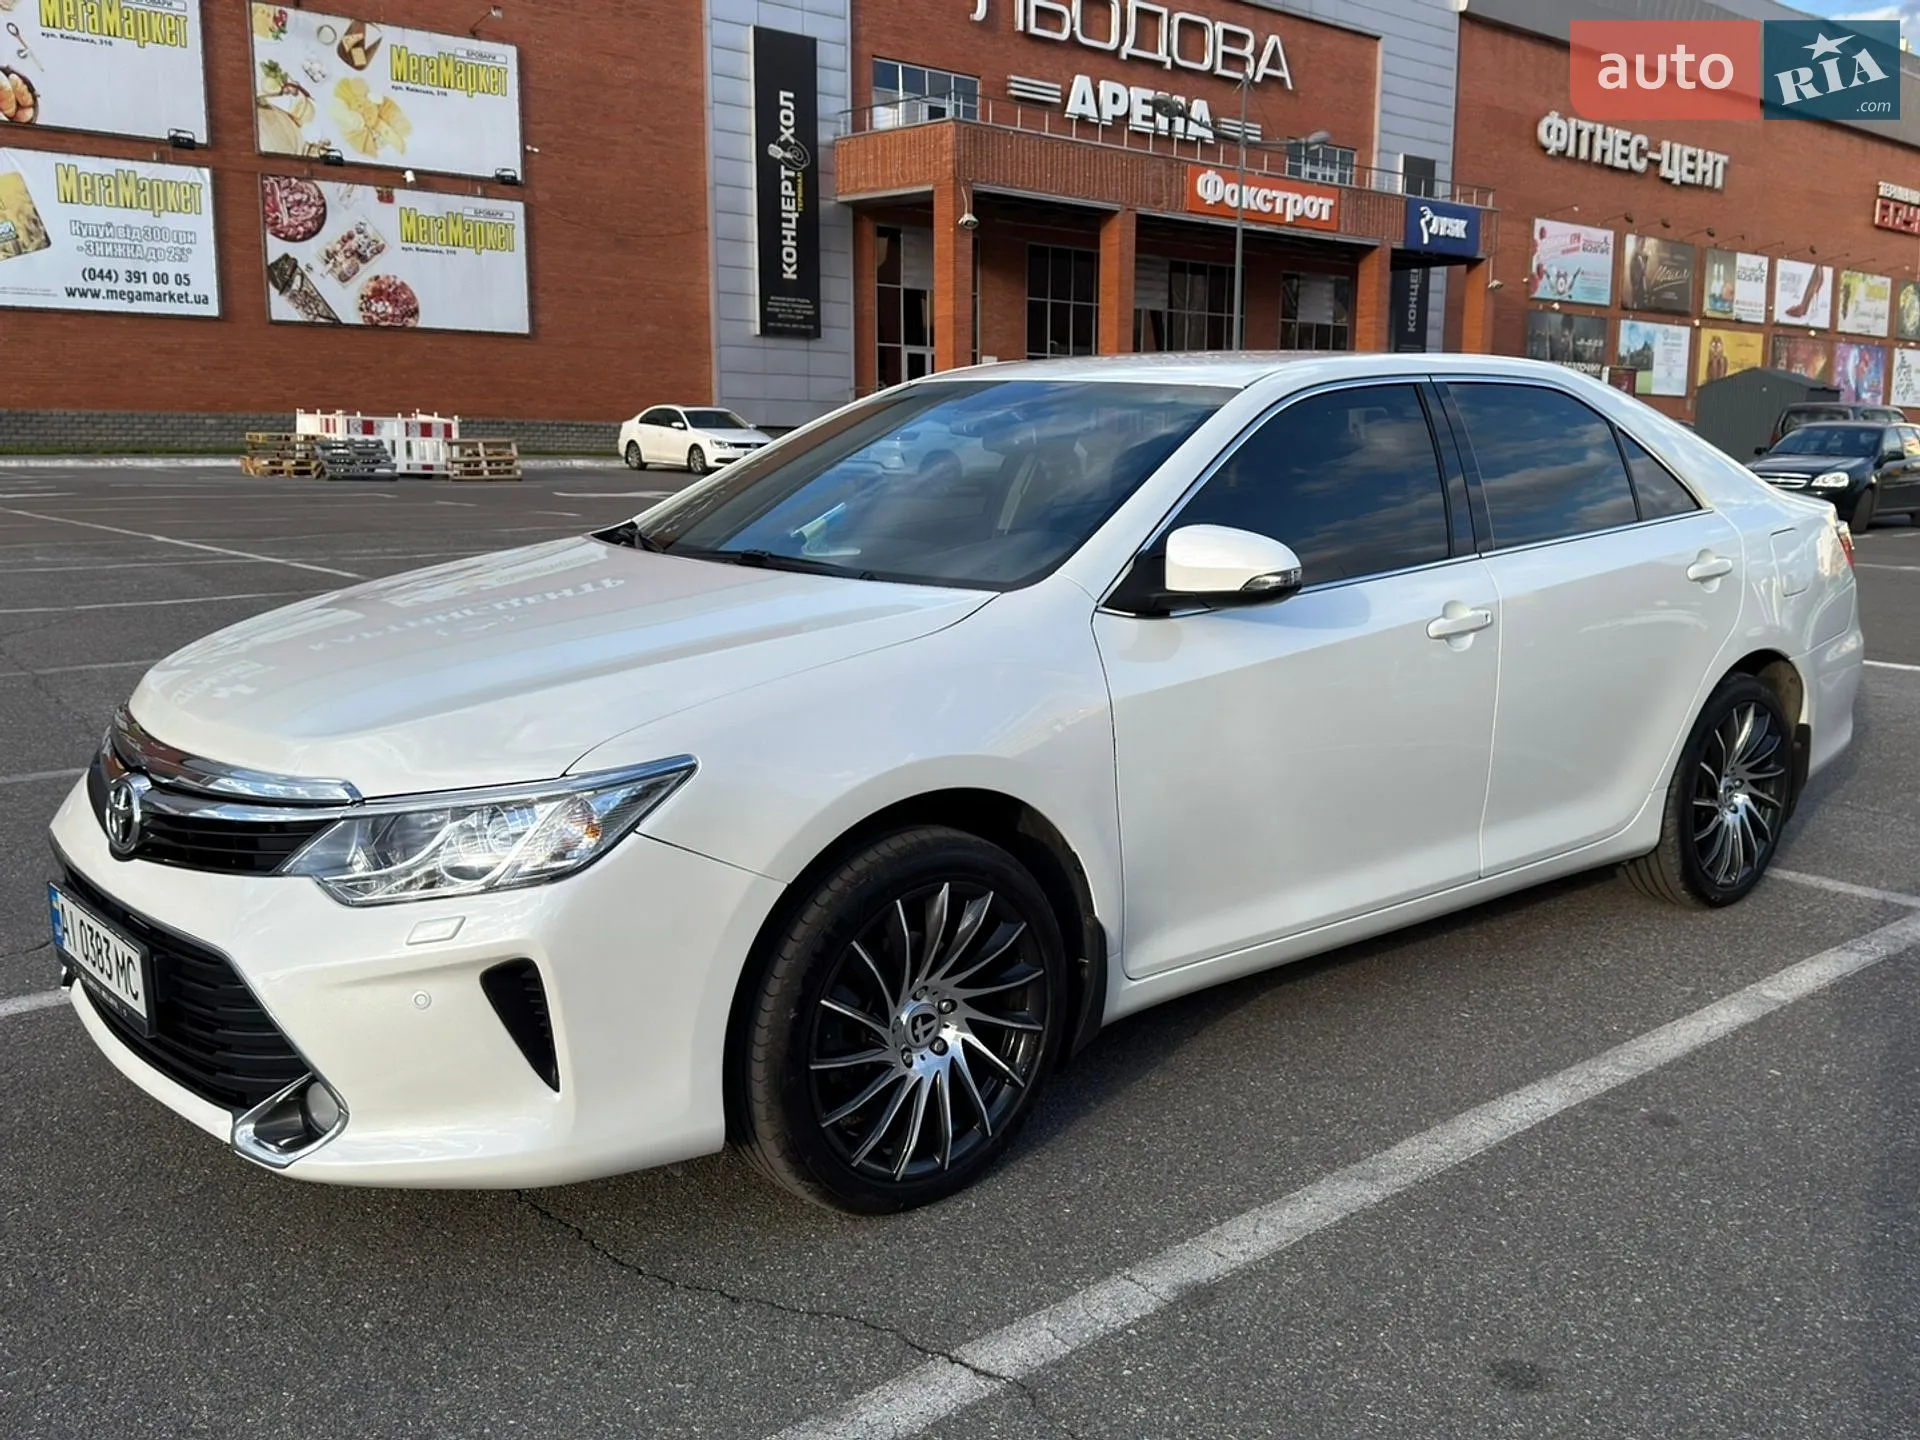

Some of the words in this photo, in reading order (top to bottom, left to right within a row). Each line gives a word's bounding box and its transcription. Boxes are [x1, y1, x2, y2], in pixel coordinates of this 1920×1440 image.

[40, 0, 188, 48] МегаМаркет
[390, 44, 508, 98] МегаМаркет
[779, 90, 795, 144] ХОЛ
[1064, 74, 1215, 144] АРЕНА
[1536, 110, 1730, 190] ФІТНЕС-ЦЕНТ
[55, 162, 203, 217] МегаМаркет
[1196, 169, 1335, 222] Фокстрот
[69, 219, 115, 239] Купуй
[143, 226, 171, 242] 300
[399, 207, 515, 255] МегаМаркет
[780, 165, 798, 280] КОНЦЕРТ
[1428, 214, 1468, 240] JYSK
[81, 267, 119, 284] (044)
[125, 270, 147, 284] 391
[153, 272, 169, 285] 00
[174, 273, 191, 287] 05
[146, 246, 166, 263] до
[64, 286, 209, 305] www.megamarket.ua
[61, 903, 78, 953] AI
[79, 919, 113, 981] 0383
[114, 944, 139, 1001] MC
